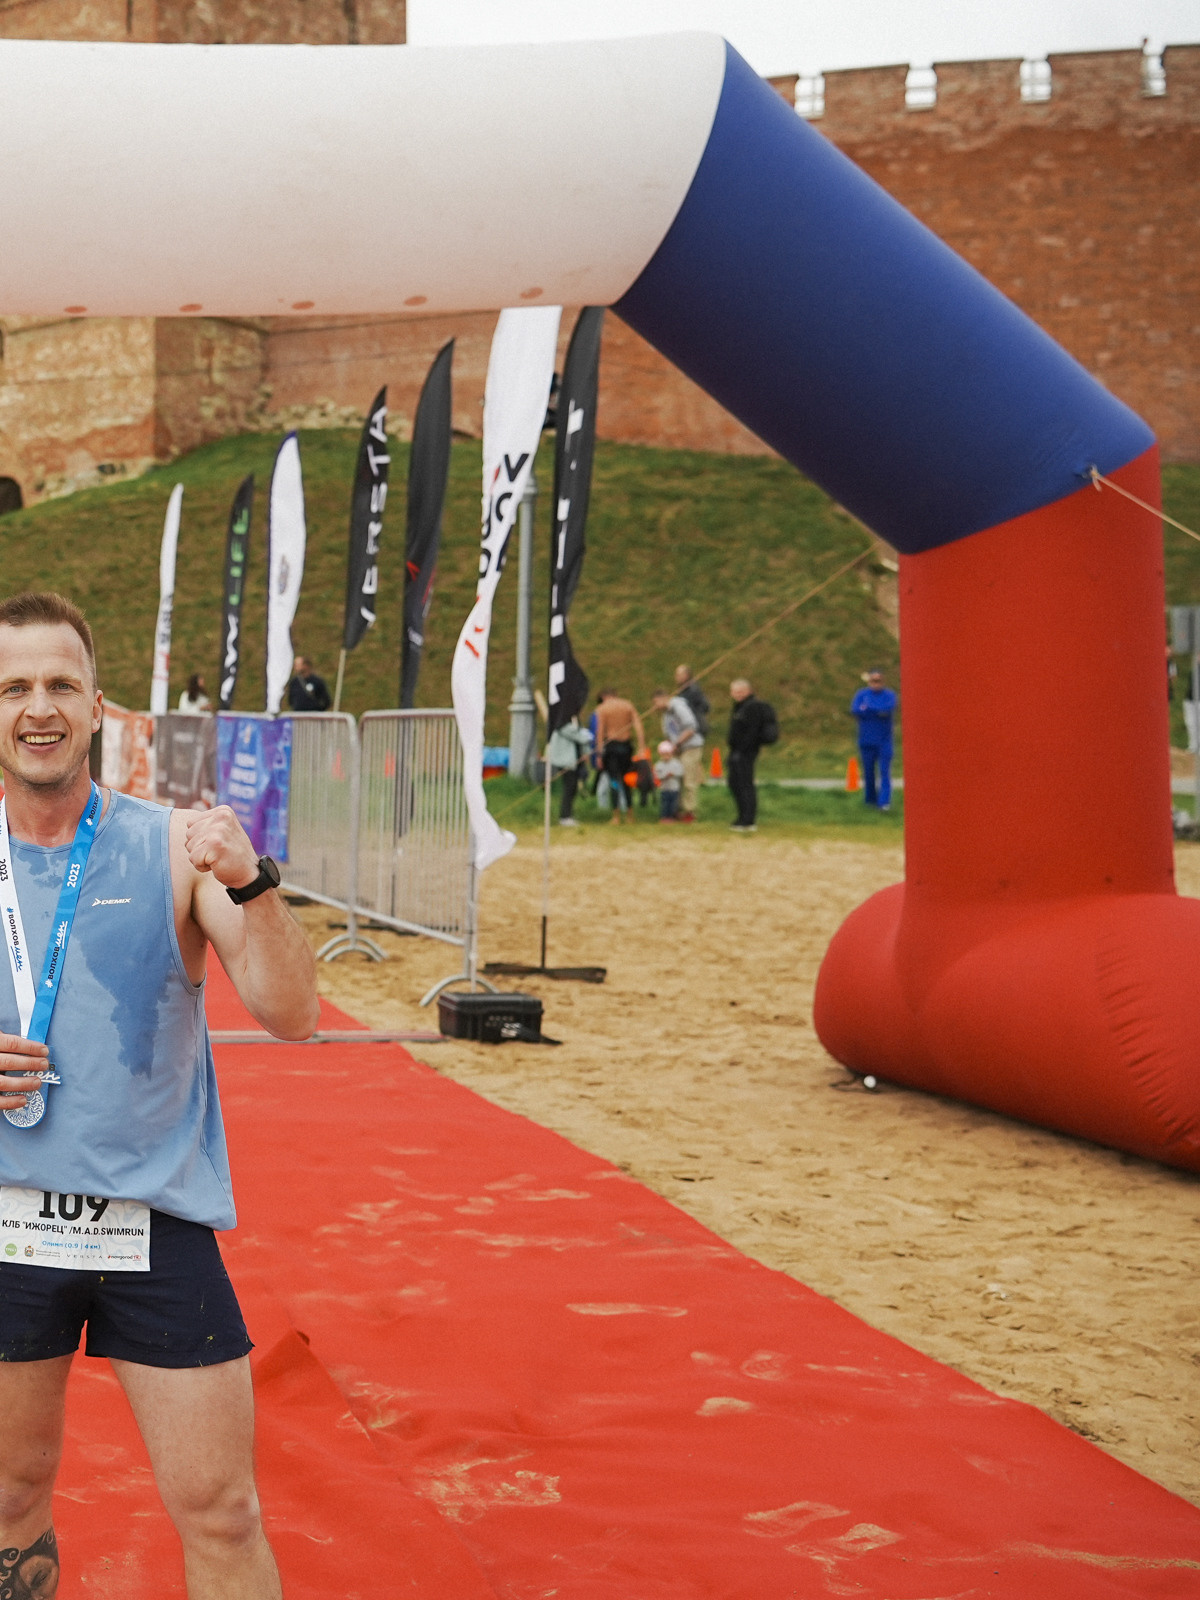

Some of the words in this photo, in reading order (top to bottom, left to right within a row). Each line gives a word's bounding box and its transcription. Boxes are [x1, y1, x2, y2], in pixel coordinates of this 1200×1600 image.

[67, 863, 81, 888] 2023
[100, 897, 132, 905] DEMIX
[38, 1190, 110, 1222] 109
[2, 1219, 21, 1229] КЛБ
[22, 1221, 68, 1235] "ИЖОРЕЦ"
[68, 1226, 144, 1237] /M.A.D.SWIMRUN
